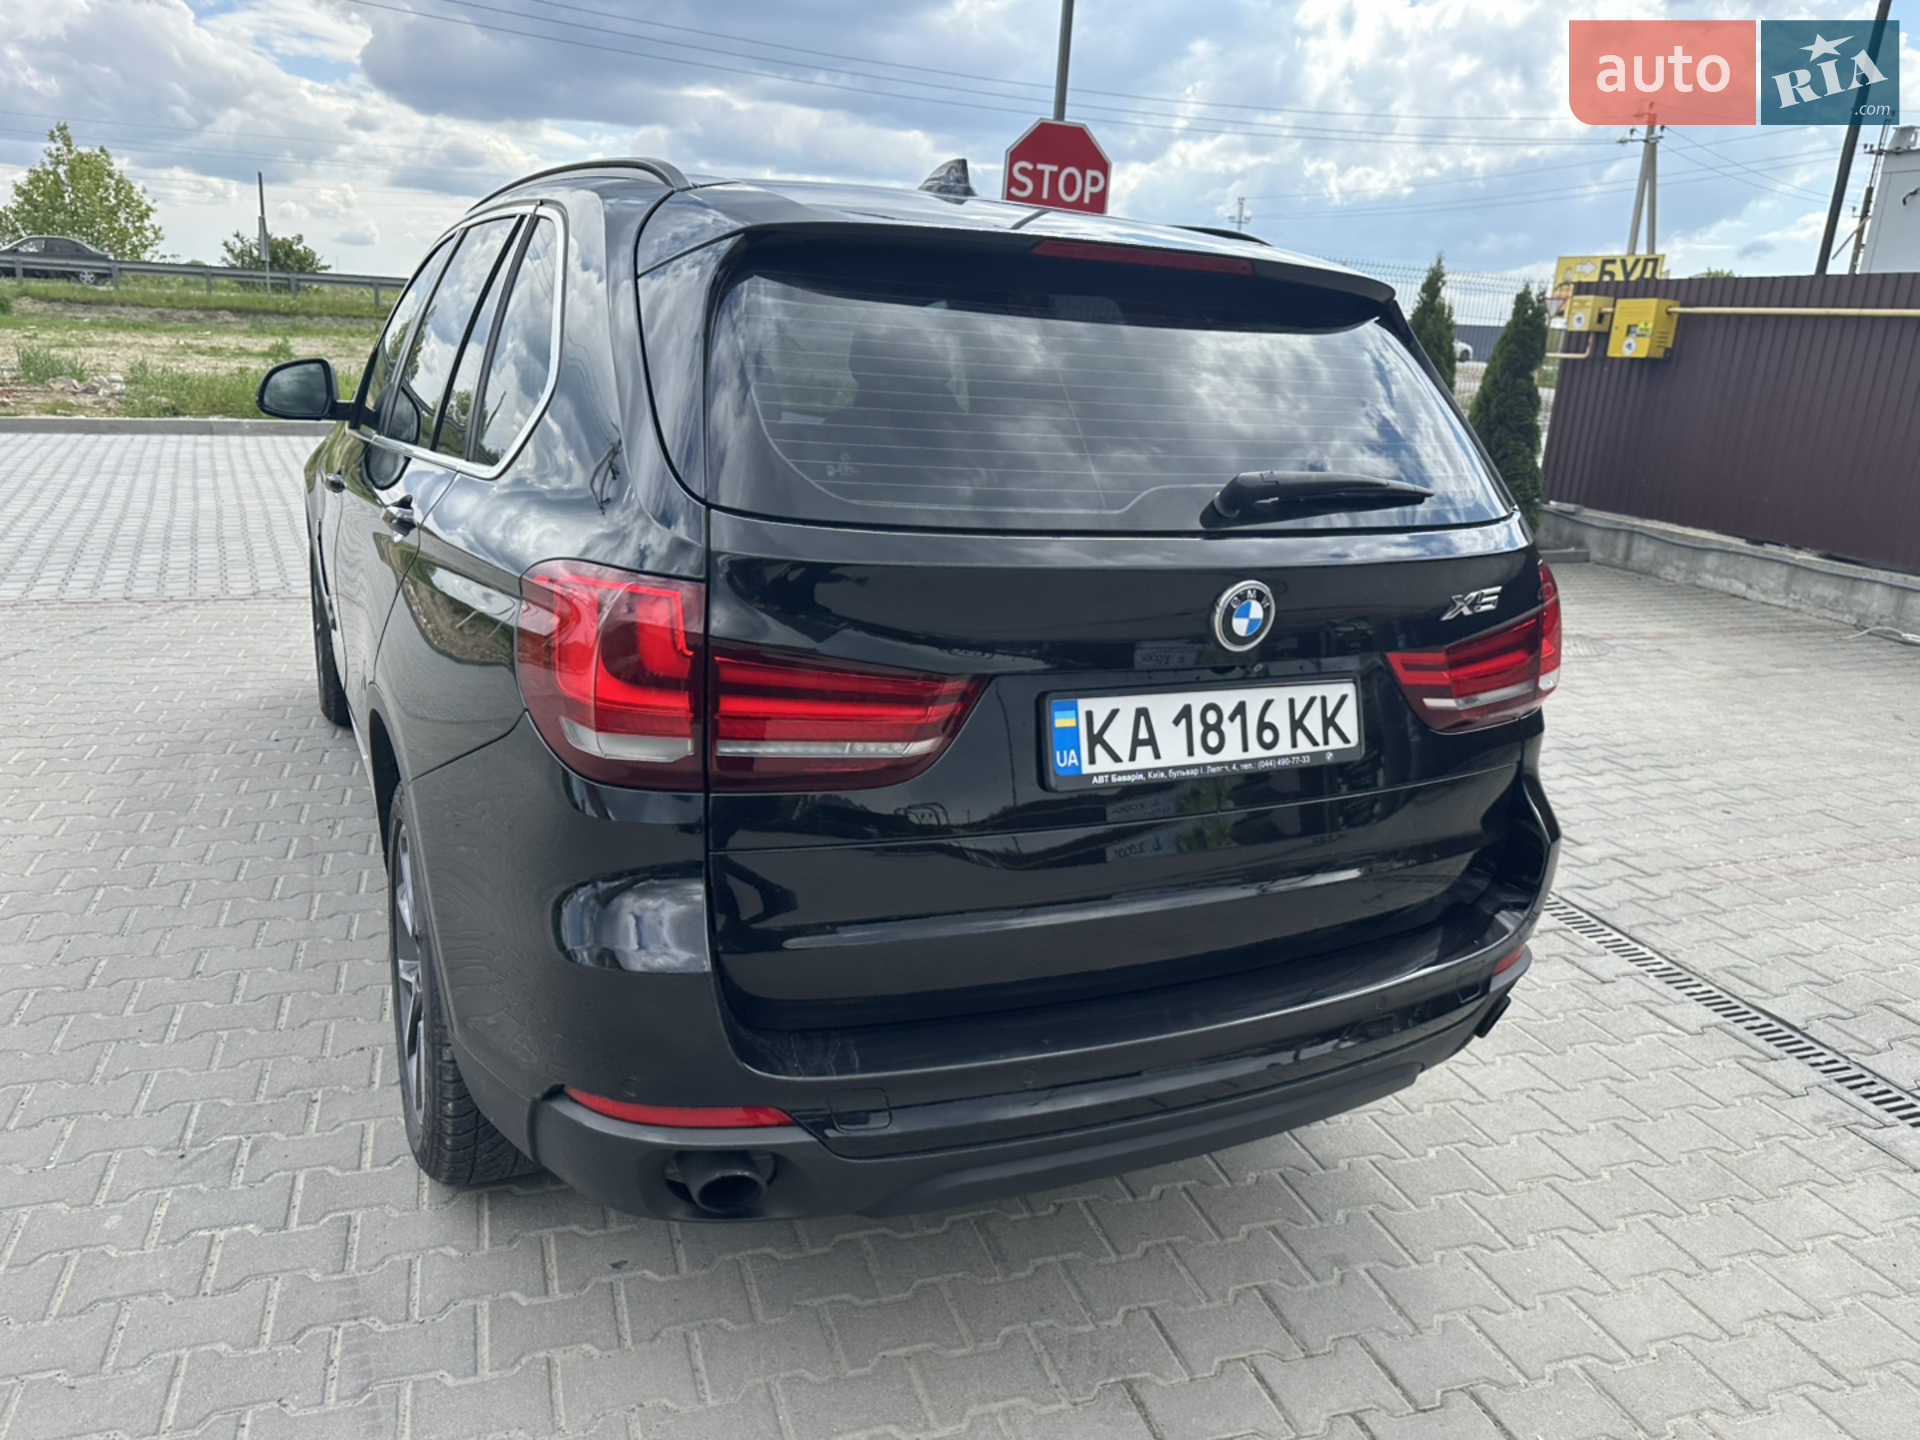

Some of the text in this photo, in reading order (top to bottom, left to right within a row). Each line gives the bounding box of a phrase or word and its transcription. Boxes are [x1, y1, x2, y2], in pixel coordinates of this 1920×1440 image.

[1009, 160, 1105, 204] STOP
[1440, 585, 1502, 621] X5
[1172, 698, 1280, 757] 1816
[1055, 749, 1079, 768] UA
[1257, 758, 1277, 770] (044)
[1277, 755, 1311, 767] 490-77-33
